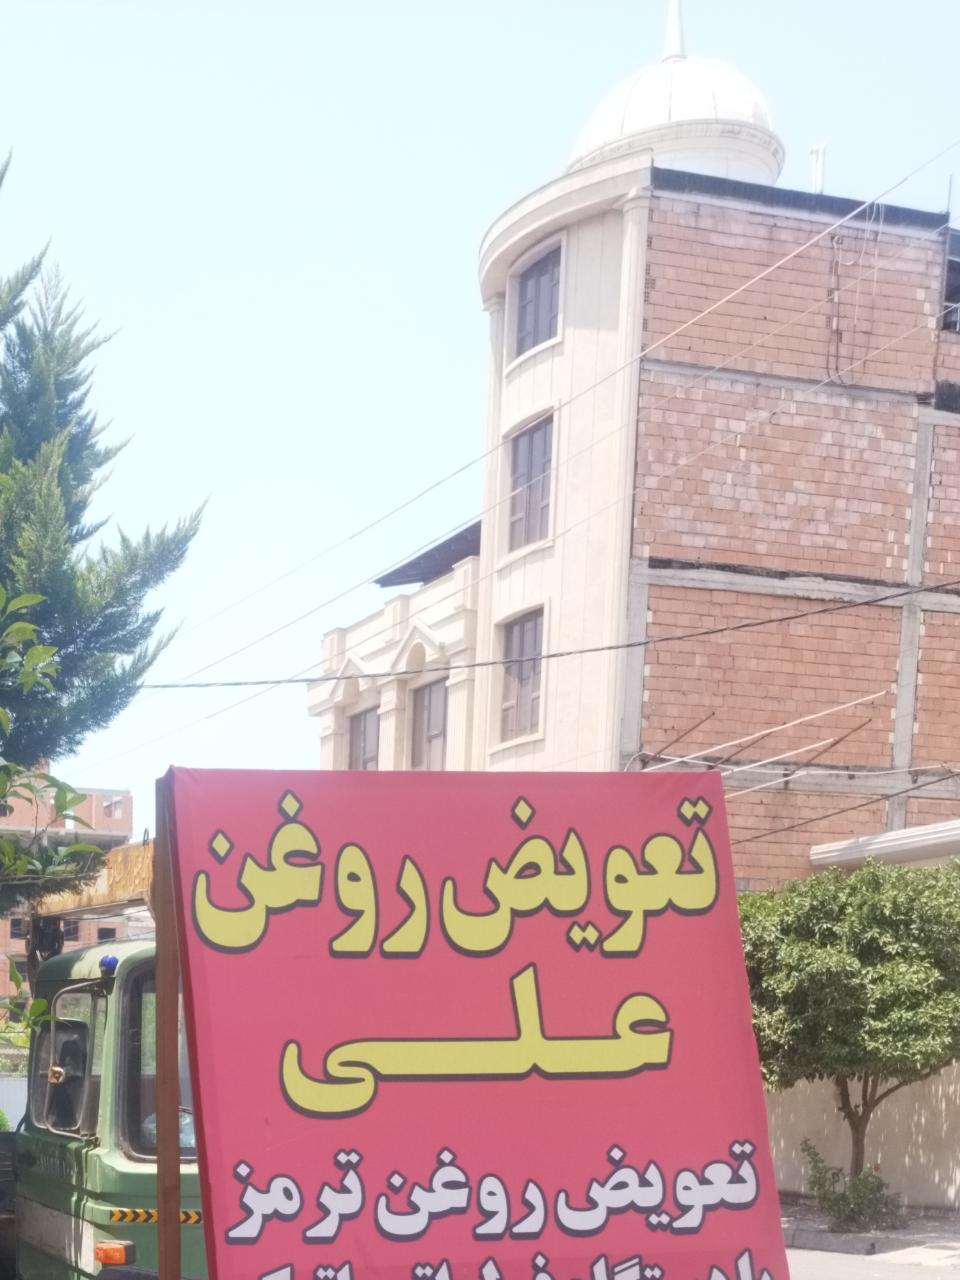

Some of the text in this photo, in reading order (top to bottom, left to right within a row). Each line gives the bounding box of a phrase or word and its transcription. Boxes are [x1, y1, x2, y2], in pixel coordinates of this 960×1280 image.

[192, 788, 721, 960] تعویض روغن
[279, 963, 673, 1121] علی
[226, 1140, 760, 1244] تعویض روغن ترمز
